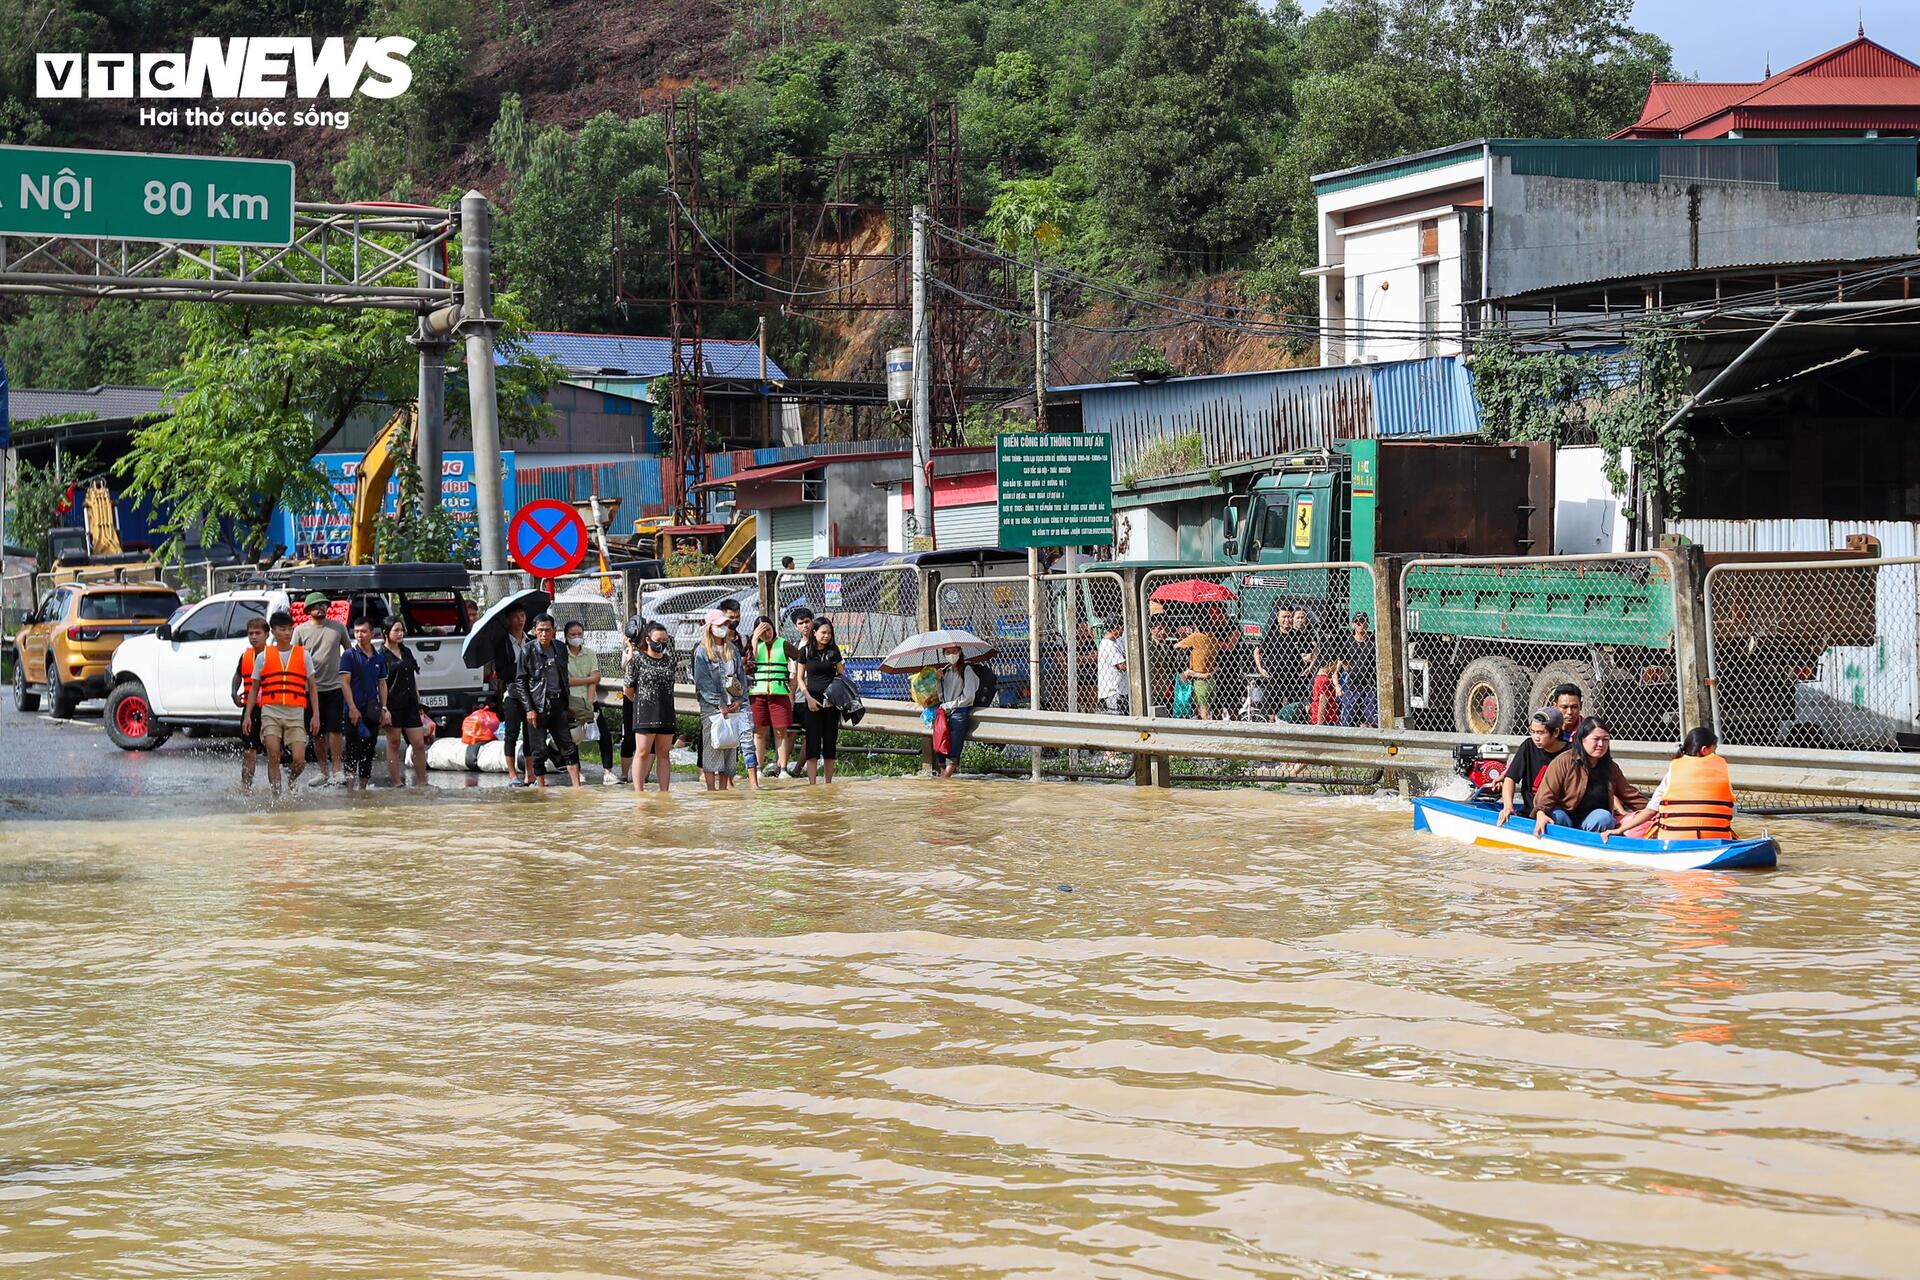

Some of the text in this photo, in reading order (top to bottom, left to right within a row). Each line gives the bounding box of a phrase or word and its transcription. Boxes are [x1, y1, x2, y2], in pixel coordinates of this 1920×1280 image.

[20, 167, 269, 220] NỘI 80 km
[1020, 435, 1038, 446] CÔNG
[1040, 434, 1049, 446] BỐ
[1050, 435, 1071, 446] THÔNG
[1073, 437, 1083, 447] TIN
[1084, 436, 1093, 449] DỰ
